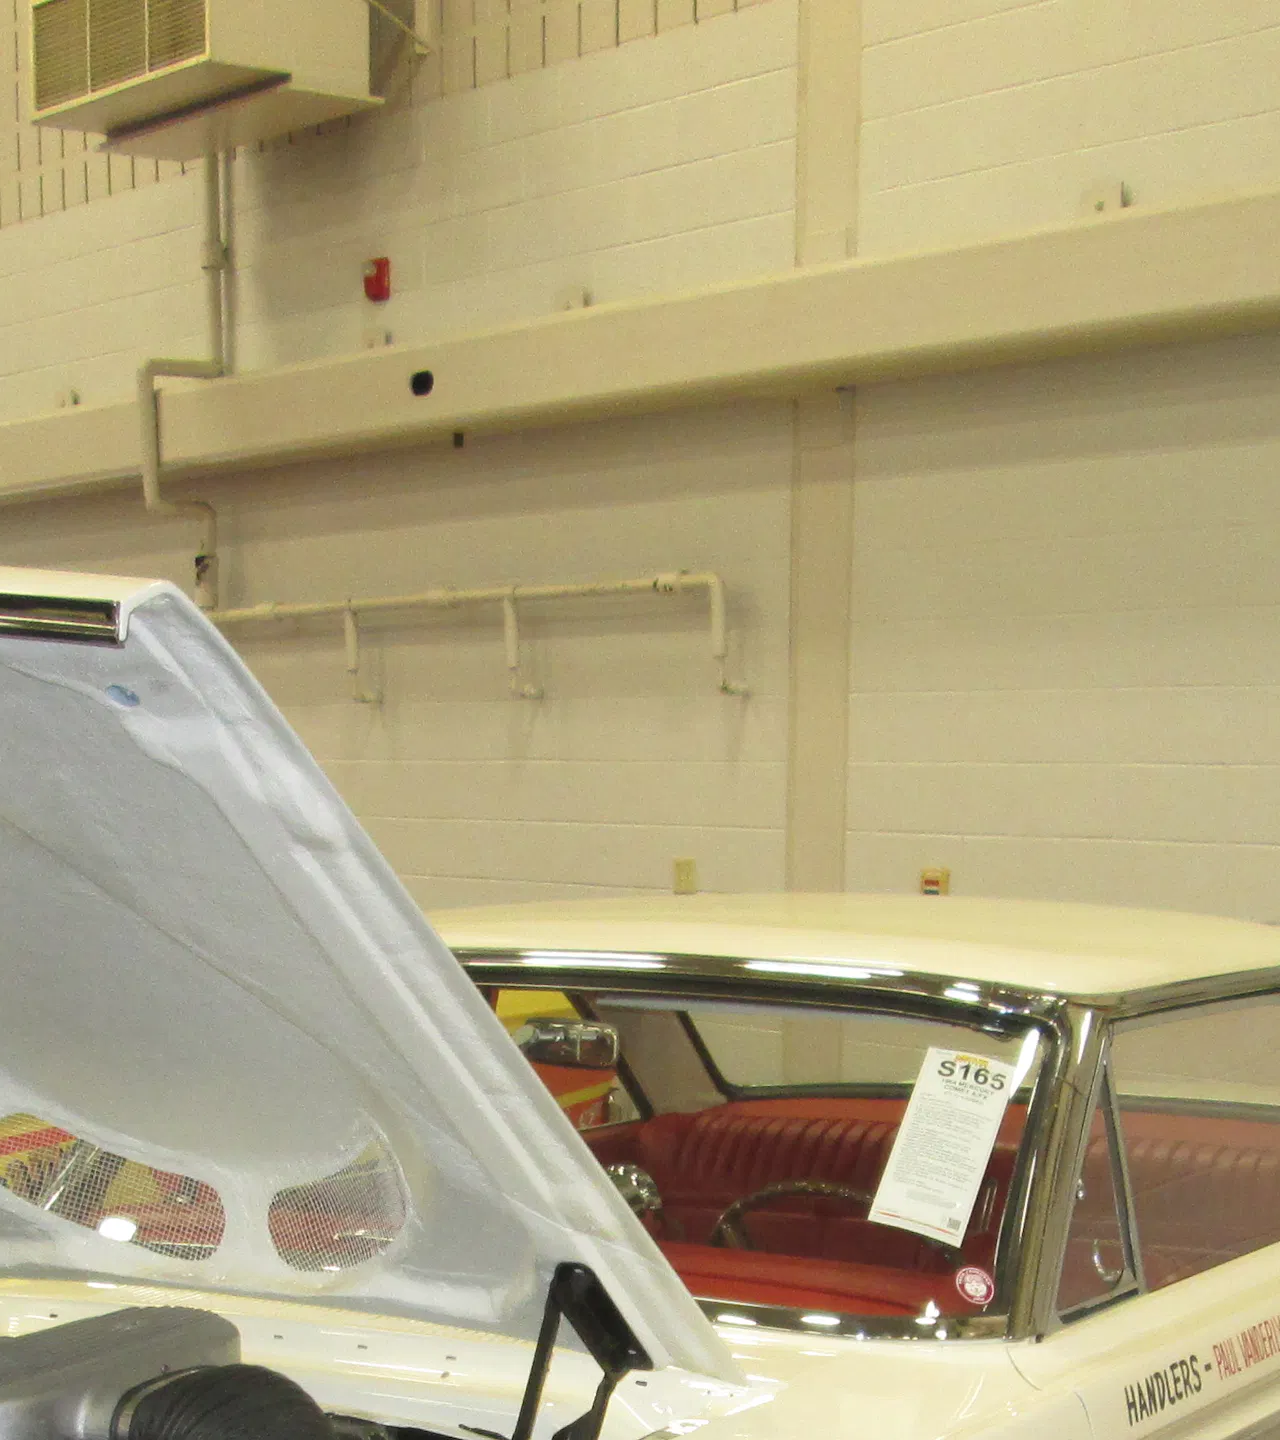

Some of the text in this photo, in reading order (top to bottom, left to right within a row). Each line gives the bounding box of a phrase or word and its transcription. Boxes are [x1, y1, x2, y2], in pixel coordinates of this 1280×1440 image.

[937, 1060, 1007, 1091] S165
[1124, 1354, 1202, 1427] HANDLERS
[1212, 1337, 1242, 1380] PAUL
